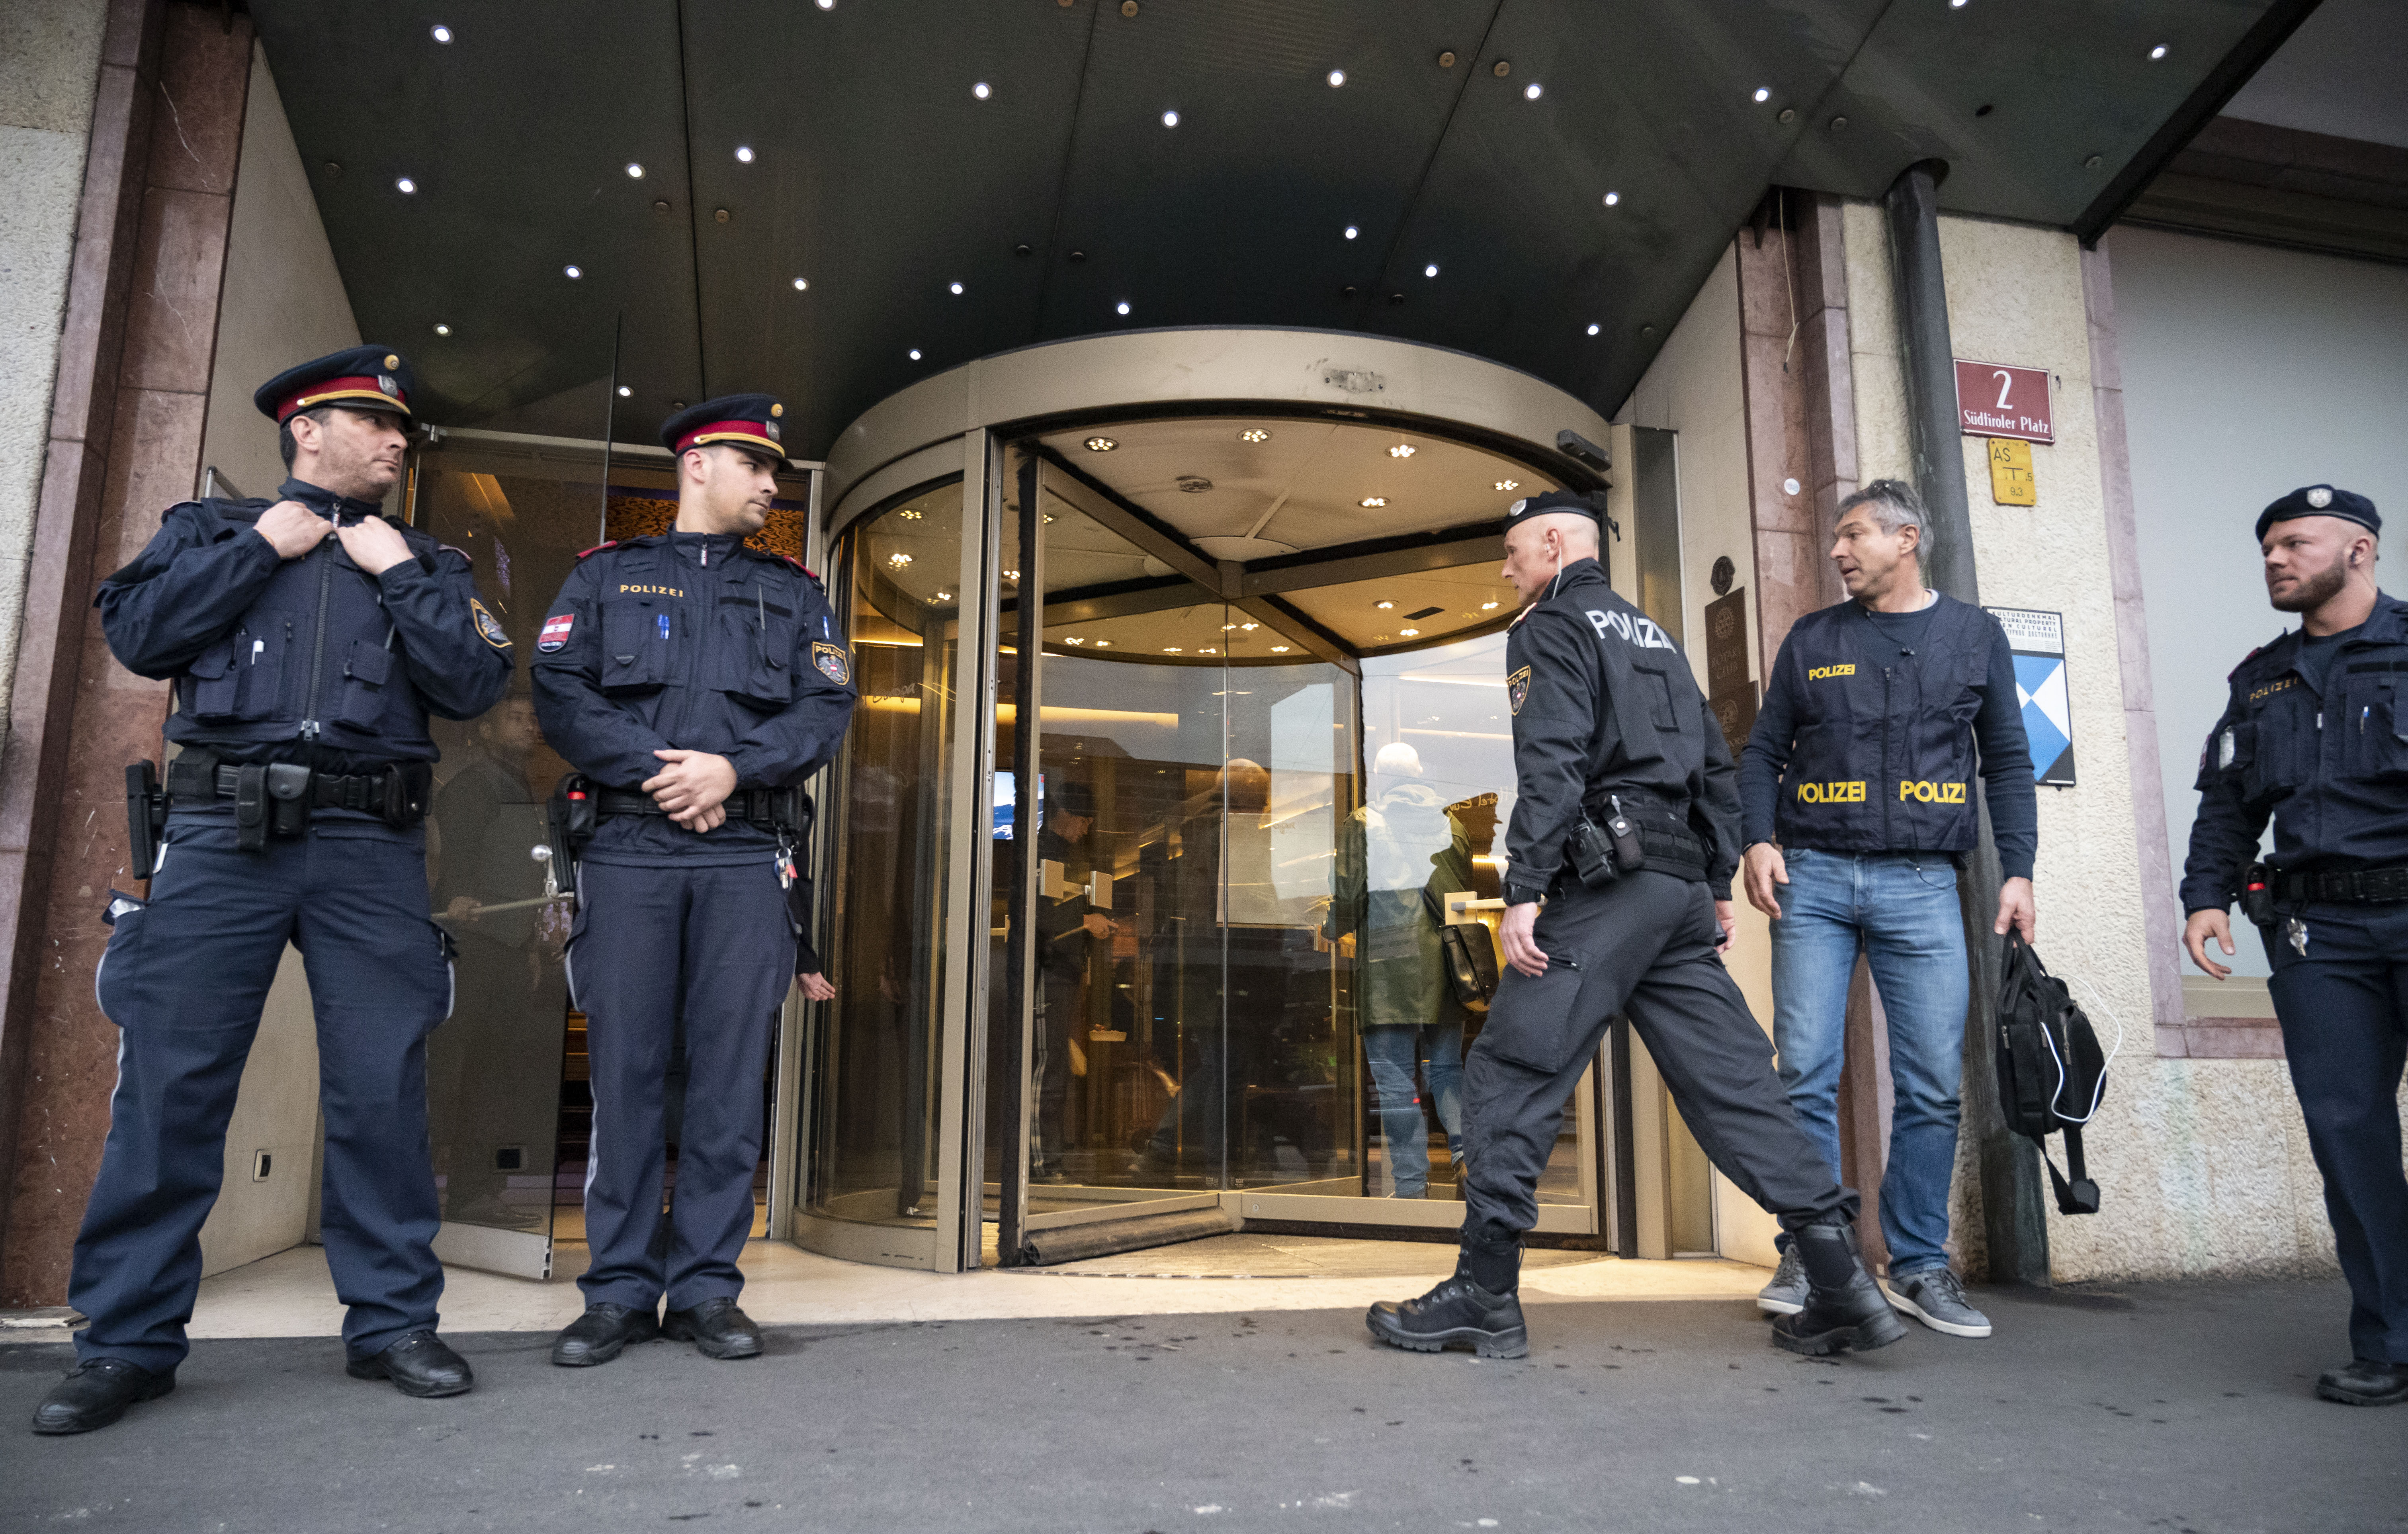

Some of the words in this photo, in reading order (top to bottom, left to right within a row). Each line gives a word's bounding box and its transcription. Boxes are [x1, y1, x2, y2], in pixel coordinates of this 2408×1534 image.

[1993, 370, 2013, 409] 2
[1964, 410, 2015, 430] Südtiroler
[2021, 417, 2049, 434] Platz
[1994, 447, 2011, 462] AS
[2010, 487, 2023, 496] 9.3
[620, 585, 684, 597] POLIZEI
[1992, 611, 2056, 620] KULTURDENKMAL
[1808, 664, 1855, 681] POLIZEI
[2250, 677, 2297, 702] POLIZEI
